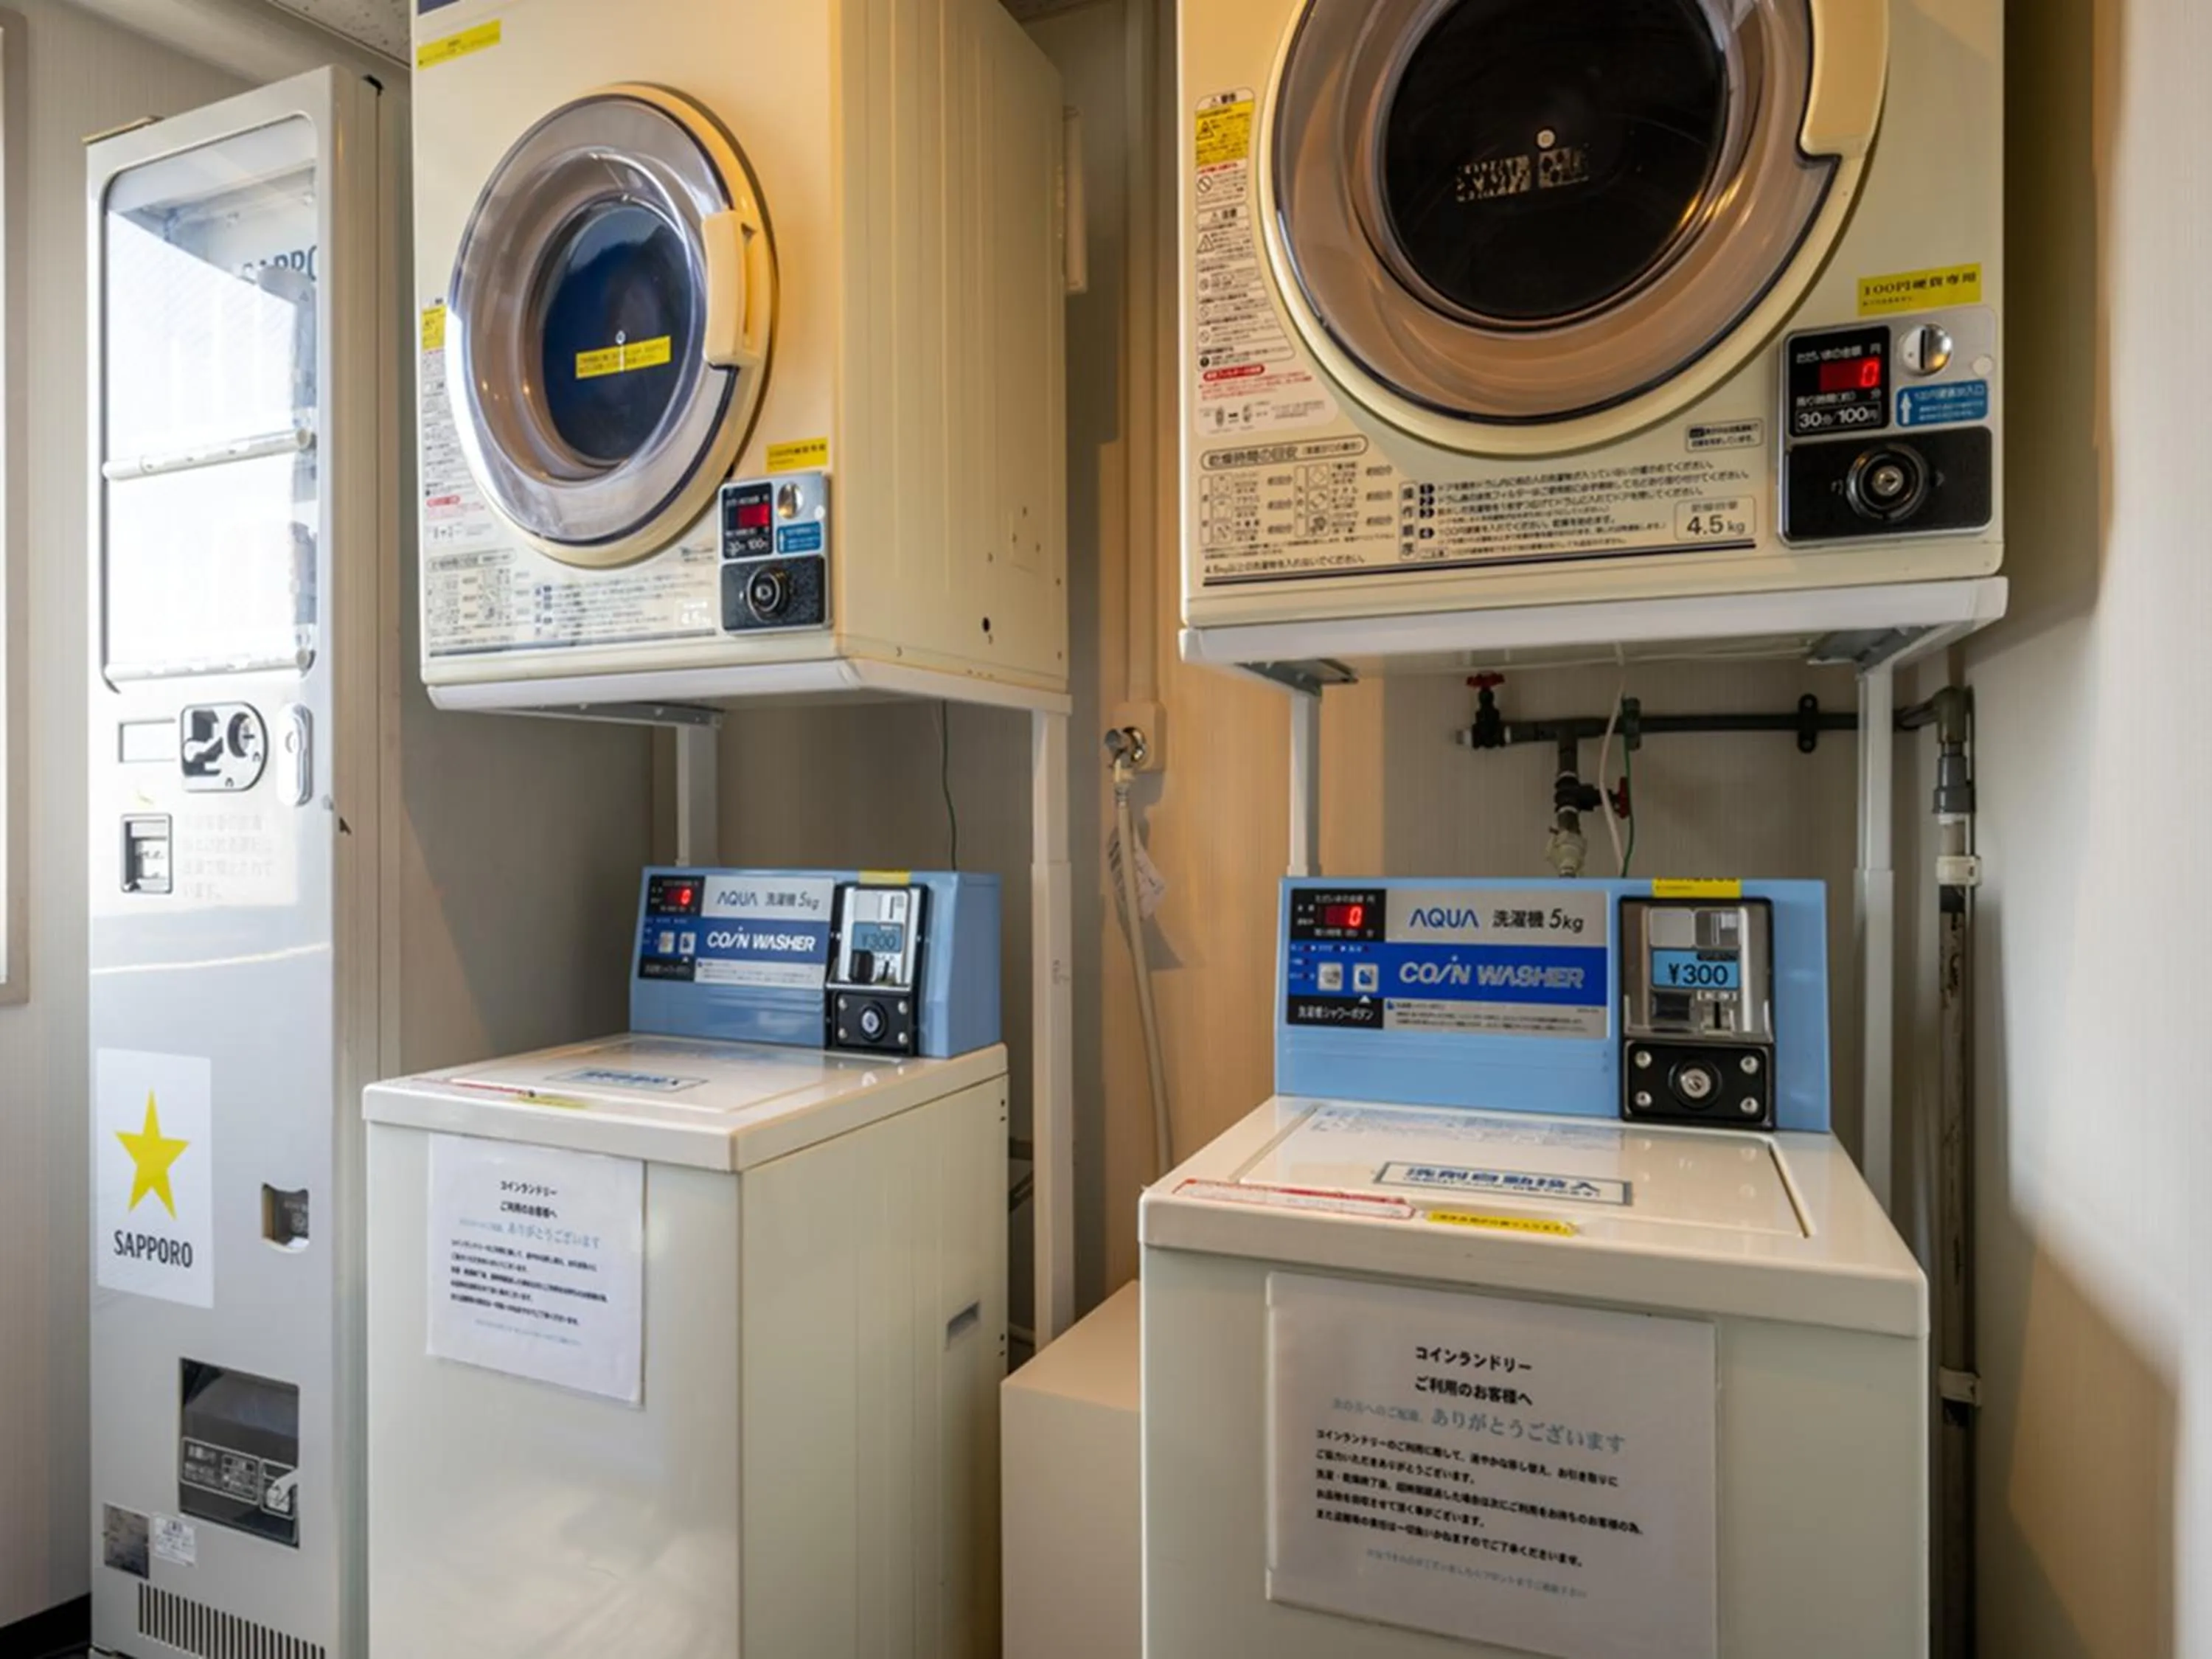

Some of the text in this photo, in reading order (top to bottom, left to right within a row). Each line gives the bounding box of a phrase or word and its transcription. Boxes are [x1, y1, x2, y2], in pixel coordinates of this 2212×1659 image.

[1860, 359, 1880, 388] 0
[1686, 514, 1724, 535] 4.5
[1728, 519, 1746, 535] kg
[717, 891, 759, 907] AQUA
[798, 890, 820, 911] 5kg
[1349, 905, 1363, 927] 0
[1409, 907, 1584, 933] AQUA 洗濯機 5kg
[752, 933, 816, 952] WASHER
[1477, 964, 1585, 989] WASHER
[1668, 962, 1729, 985] ¥300
[114, 1229, 193, 1269] SAPPORO
[1415, 1346, 1533, 1373] コインランドリー
[1415, 1375, 1534, 1406] ご利用のお客様へ
[1432, 1407, 1627, 1453] ありがとうございます
